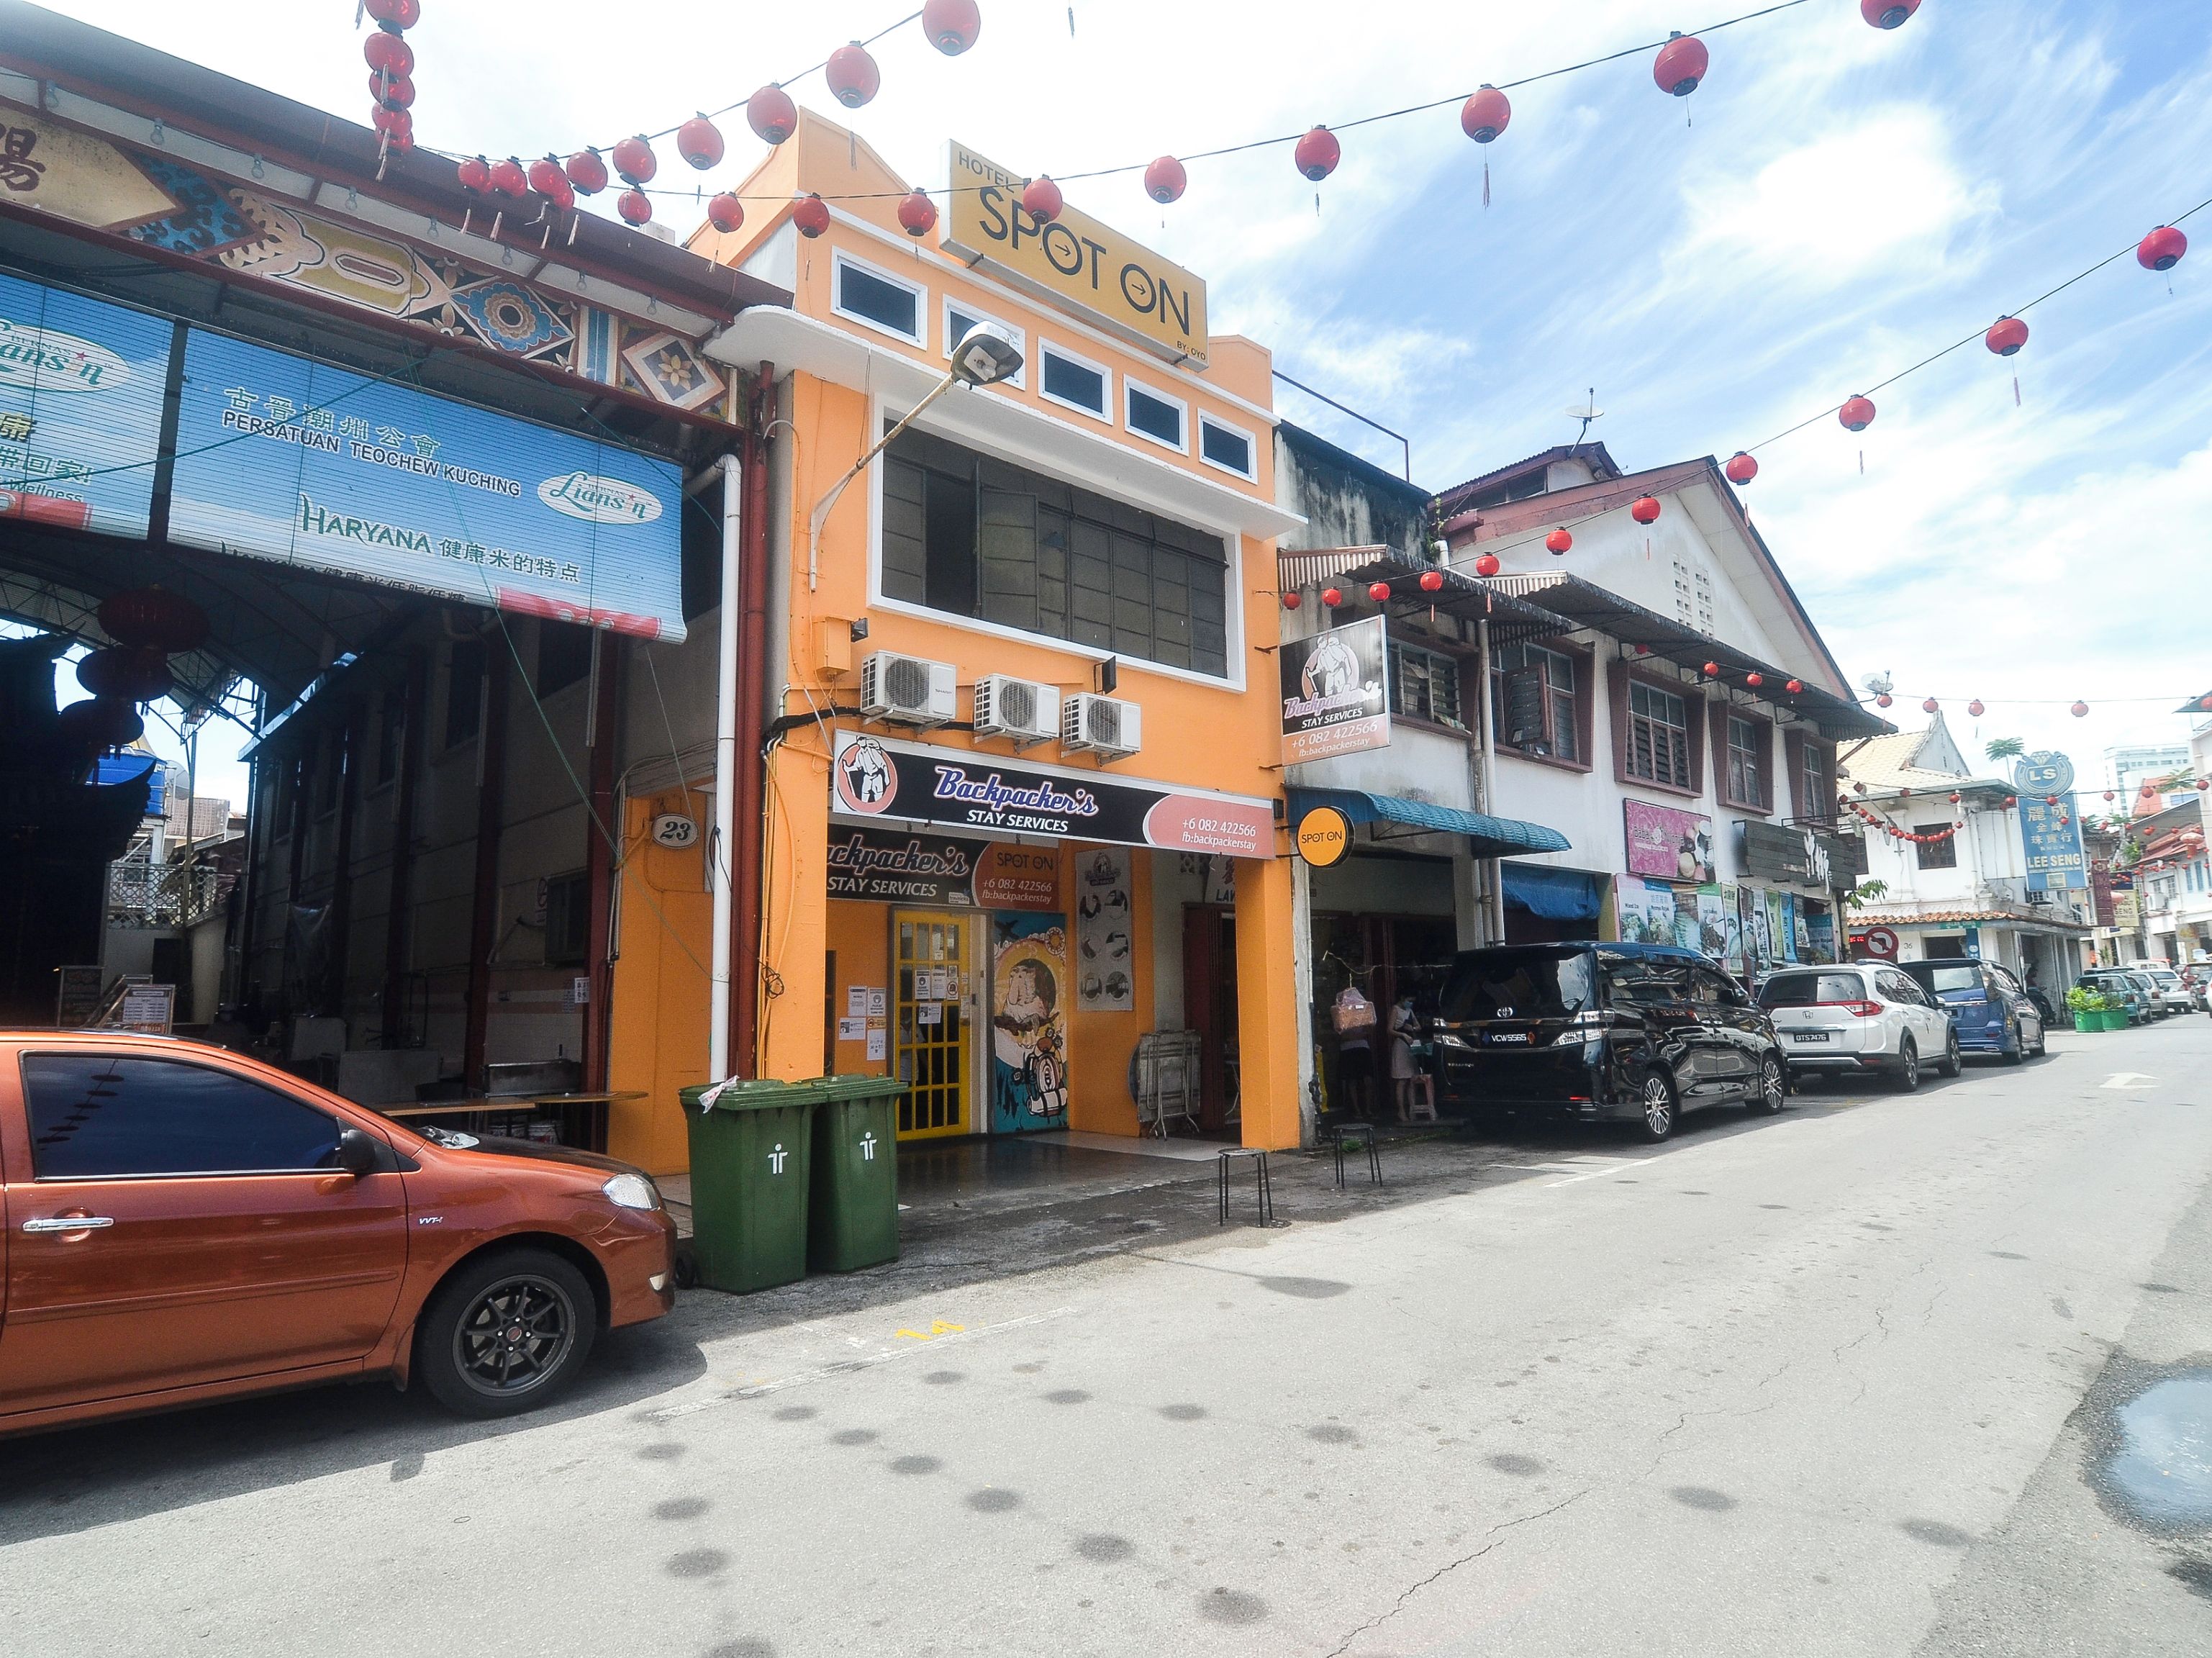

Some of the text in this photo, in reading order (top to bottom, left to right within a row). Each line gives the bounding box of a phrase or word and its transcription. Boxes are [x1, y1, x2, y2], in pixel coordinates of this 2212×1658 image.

[958, 151, 1015, 194] HOTEL
[979, 186, 1190, 337] SPOT ON
[1177, 340, 1207, 361] BY: OYO
[223, 411, 520, 497] PERSATUAN TEOCHEW KUCHING
[301, 492, 579, 582] HARYANA 健康米的特点
[1284, 681, 1383, 719] Backpacke's
[1302, 707, 1363, 729] STAY SERVICES
[1292, 720, 1378, 748] +6 082 422566
[1299, 738, 1370, 757] fb:backpackerstay
[2029, 769, 2057, 781] LS
[935, 766, 1099, 815] Backpacker's
[660, 821, 691, 841] 23
[966, 810, 1069, 833] STAY SERVICES
[1182, 817, 1256, 837] +6 082 422566
[1182, 831, 1256, 852] fb:backpackerstay
[1301, 830, 1342, 844] SPOT ON
[827, 834, 969, 876] ckpacker's
[997, 851, 1053, 871] SPOT ON
[2027, 853, 2081, 868] LEE SENG
[827, 876, 938, 897] STAY SERVICES
[983, 878, 1052, 892] +6 082 422566
[982, 889, 1052, 905] fb:backpackerstay
